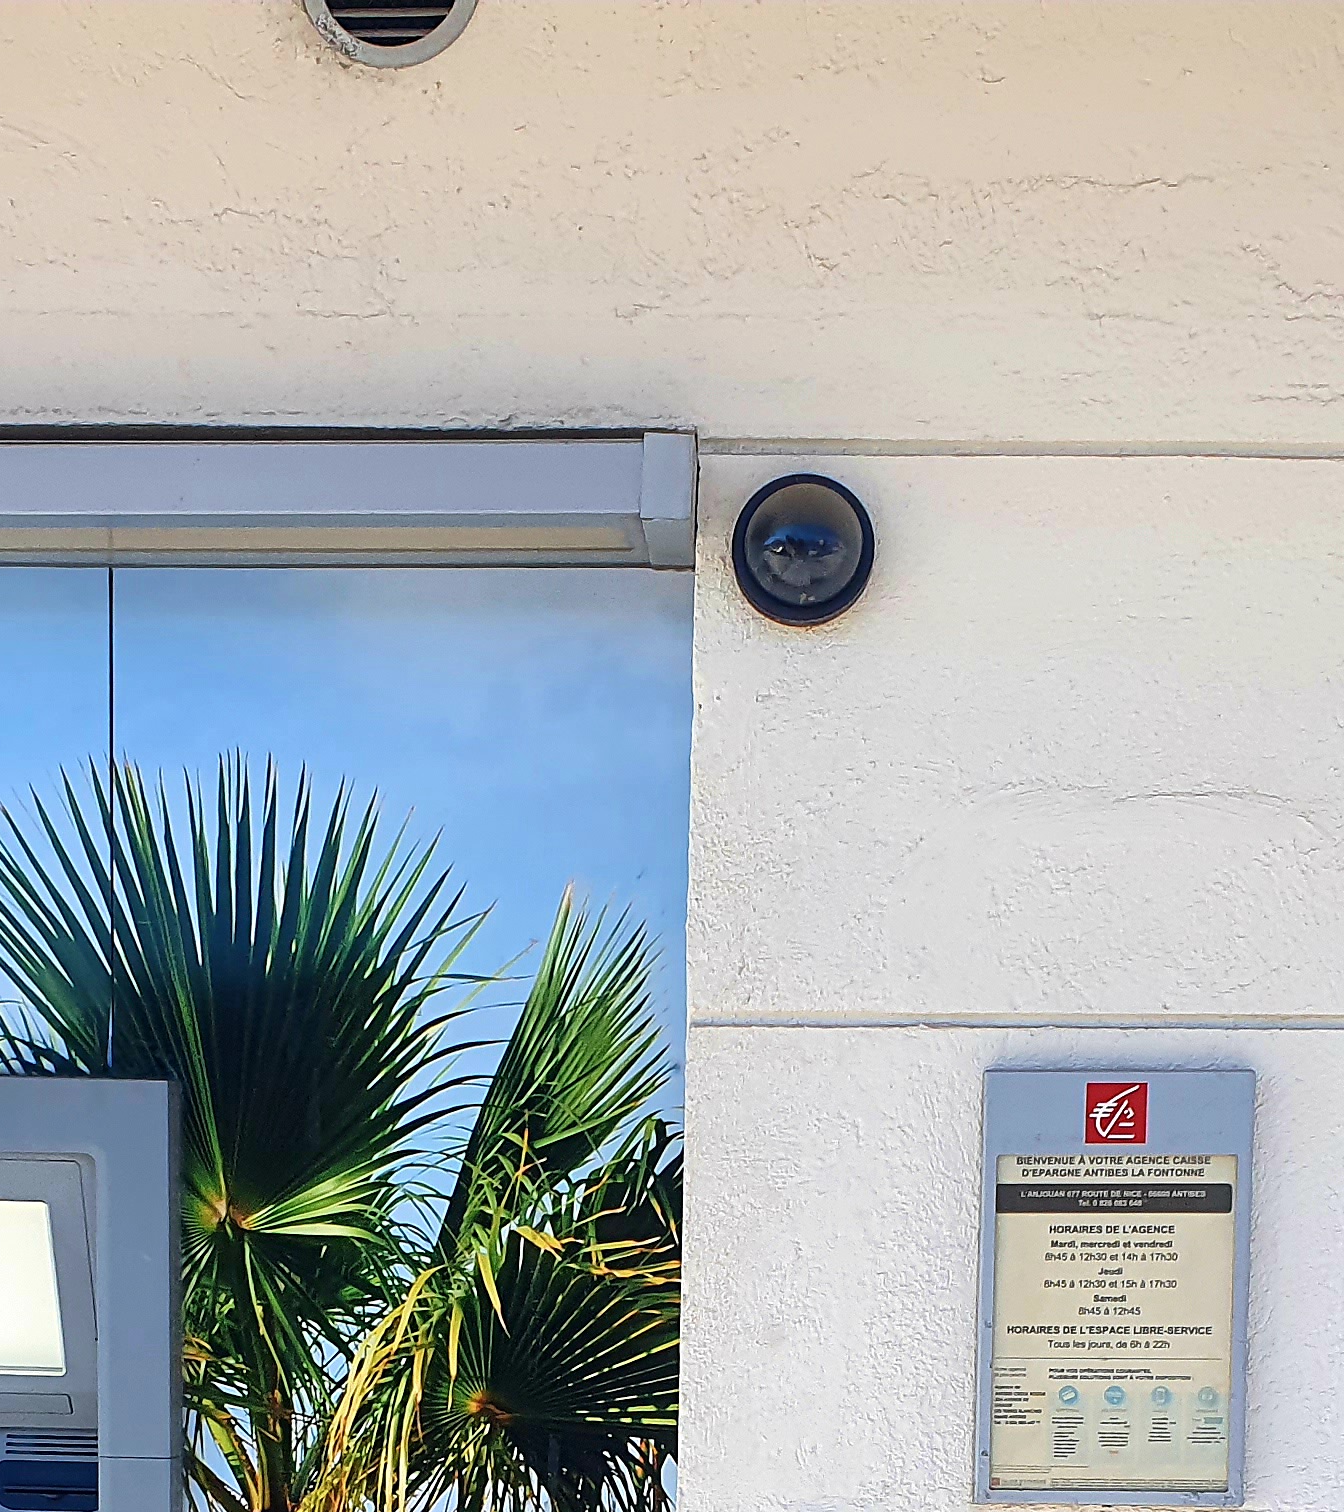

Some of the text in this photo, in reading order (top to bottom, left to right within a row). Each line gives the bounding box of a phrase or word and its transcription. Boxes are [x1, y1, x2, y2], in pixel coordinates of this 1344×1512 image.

[1016, 1156, 1076, 1165] BIENVENUE
[1087, 1156, 1124, 1165] VOTRE
[1126, 1156, 1170, 1165] AGENCE
[1173, 1156, 1211, 1165] CAISSE
[1083, 1168, 1129, 1178] ANTIBES
[1131, 1169, 1145, 1178] LA
[1148, 1169, 1205, 1178] FONTONNE
[1049, 1225, 1176, 1234] HORAIRES DE L'AGENCE
[1051, 1240, 1173, 1249] Mardi, mercredi et vendredi
[1080, 1253, 1107, 1261] 12h30
[1122, 1253, 1138, 1261] 14h
[1098, 1267, 1123, 1275] Jeudi
[1079, 1280, 1106, 1288] 12h30
[1109, 1280, 1118, 1288] et
[1121, 1280, 1137, 1288] 15h
[1149, 1280, 1177, 1288] 17h30
[1093, 1294, 1127, 1303] Samedi
[1113, 1307, 1141, 1315] 12h45
[1007, 1326, 1213, 1335] HORAIRES DE L'ESPACE LIBRE-SERVICE
[1047, 1340, 1070, 1348] Tous
[1073, 1340, 1086, 1348] les
[1115, 1340, 1128, 1349] de
